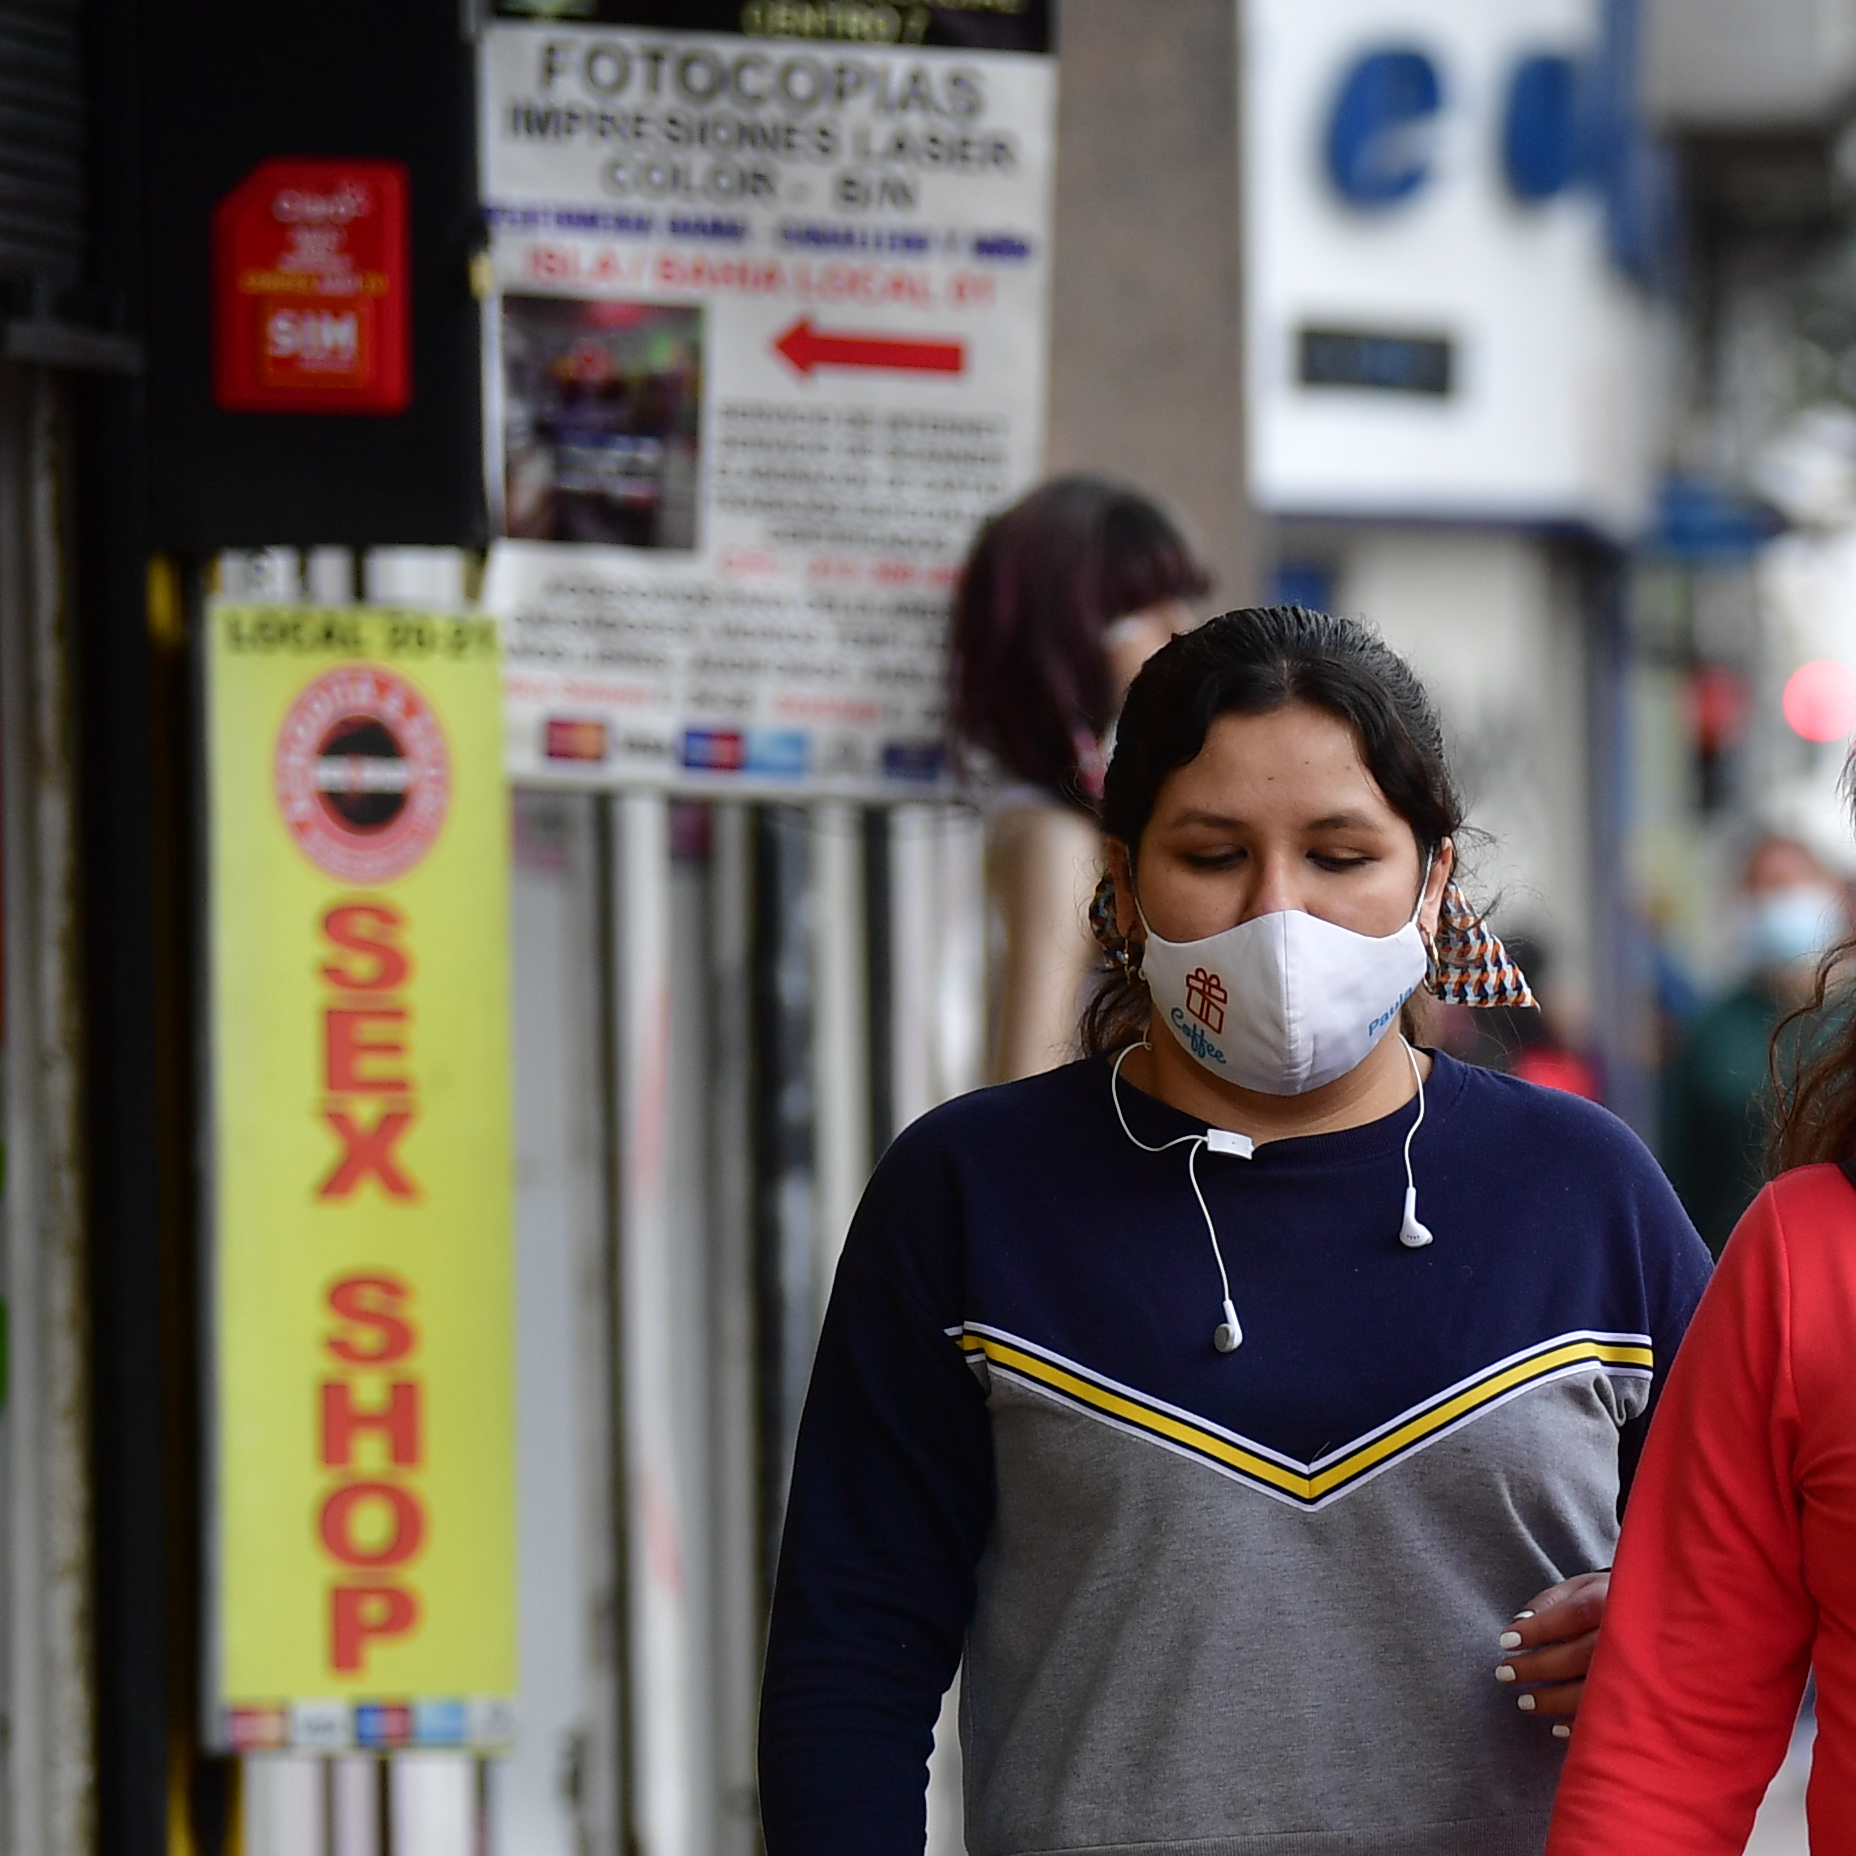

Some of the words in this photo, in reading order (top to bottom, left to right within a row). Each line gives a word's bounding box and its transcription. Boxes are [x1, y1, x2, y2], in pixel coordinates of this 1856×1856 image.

[539, 40, 985, 121] FOTOCOPIAS
[509, 103, 838, 158] IMPRESIONES
[855, 125, 1016, 171] LASER
[604, 154, 777, 203] COLOR
[269, 309, 357, 357] SIM
[224, 611, 361, 652] LOCAL
[317, 902, 418, 1205] SEX
[1169, 1005, 1227, 1065] Coffee
[317, 1276, 427, 1679] SHOP
